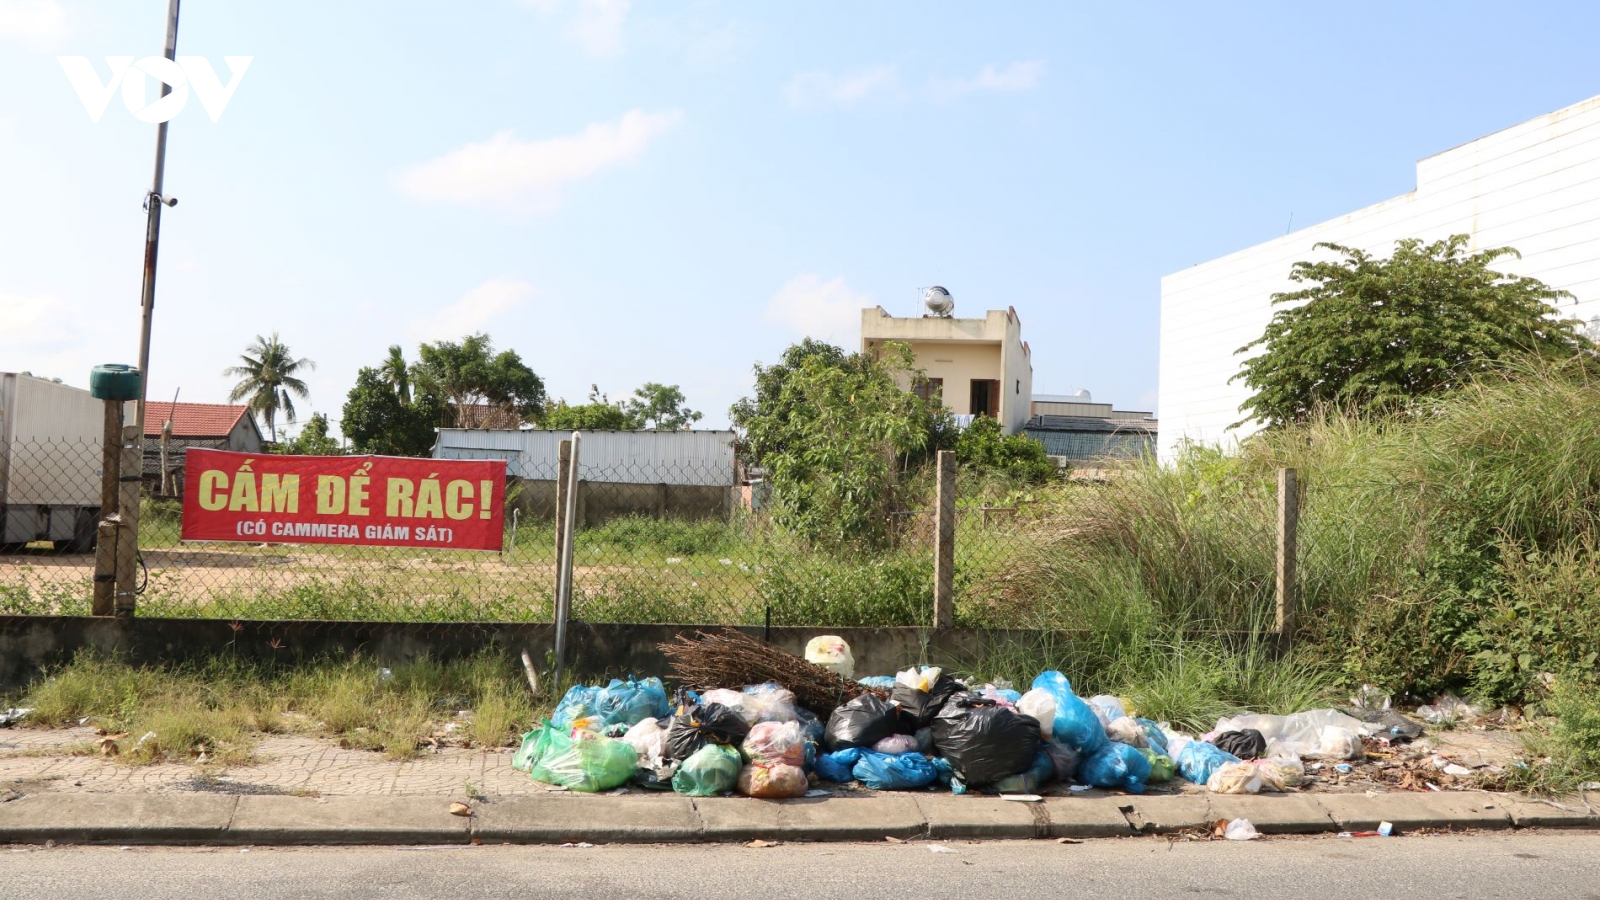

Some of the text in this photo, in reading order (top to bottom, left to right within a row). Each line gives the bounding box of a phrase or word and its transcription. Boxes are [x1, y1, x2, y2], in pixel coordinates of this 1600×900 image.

[199, 459, 494, 520] CẤM ĐỂ RÁC!
[236, 519, 453, 543] (CÓ CAMMERA GIÁM SÁT)
